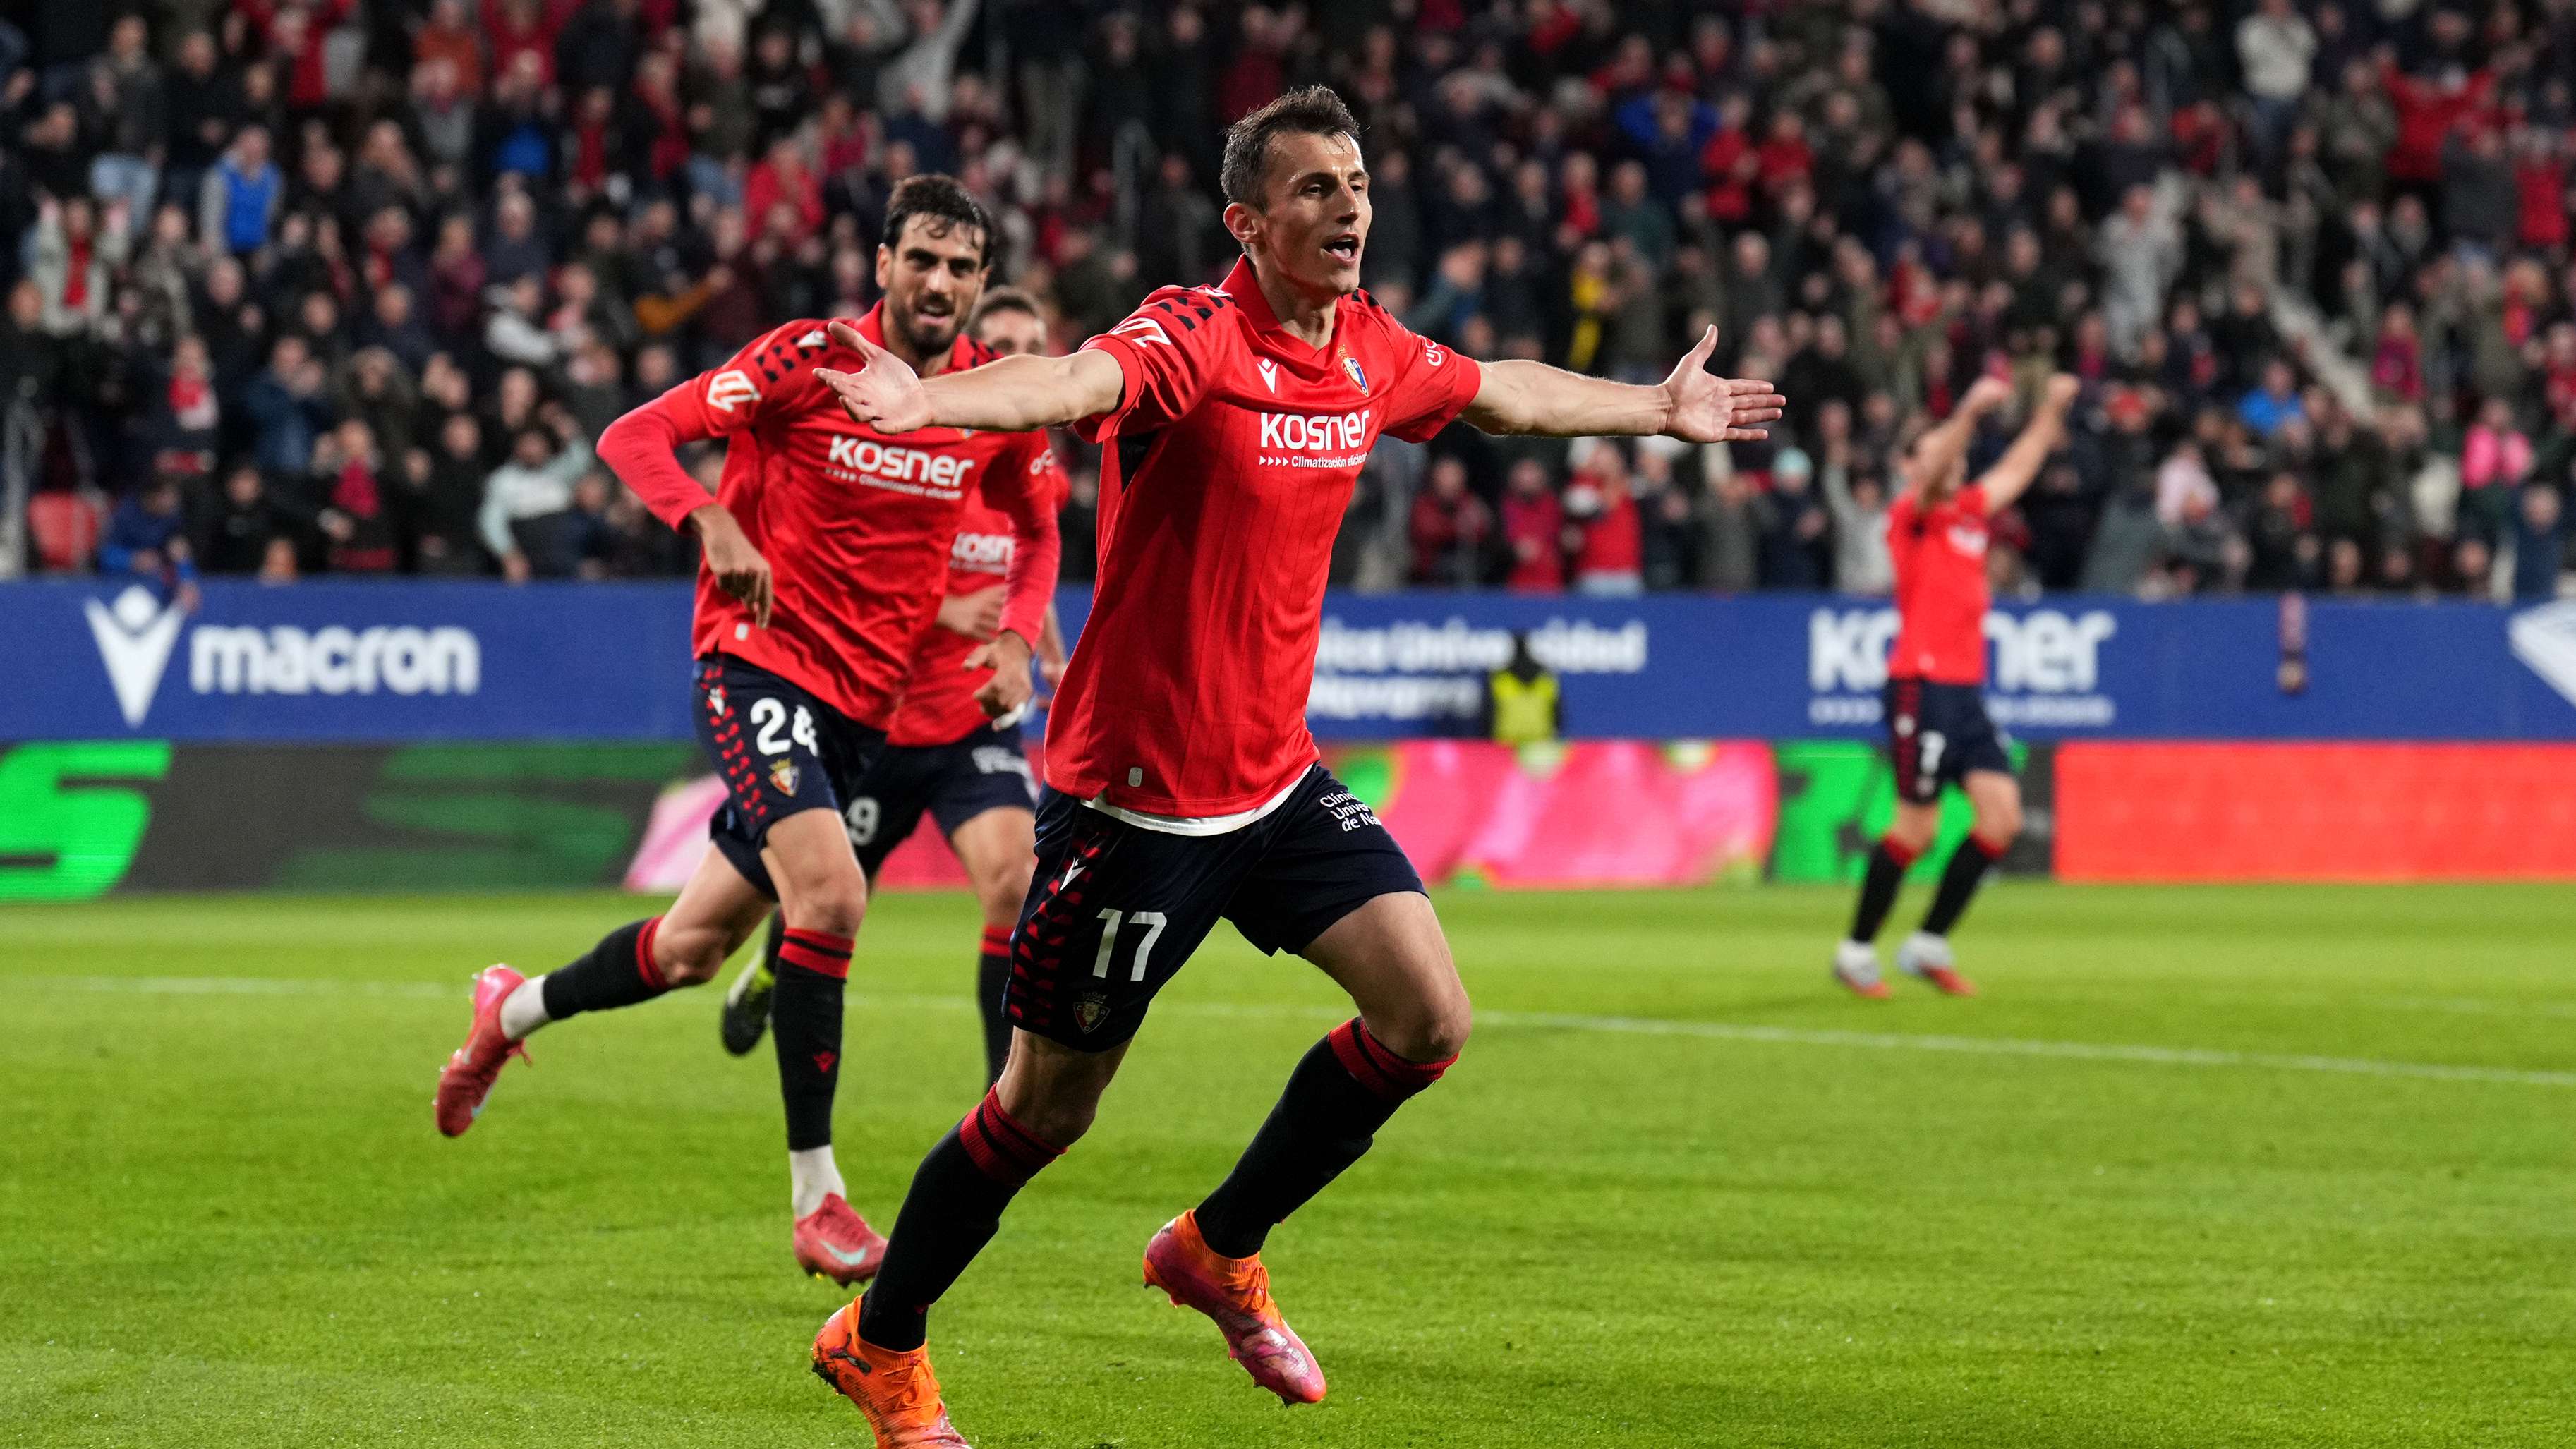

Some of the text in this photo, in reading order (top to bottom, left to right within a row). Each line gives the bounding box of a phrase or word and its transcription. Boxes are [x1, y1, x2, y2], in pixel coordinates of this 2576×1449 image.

[1291, 454, 1347, 468] Climatización
[189, 626, 482, 696] macron
[750, 696, 818, 756] 24
[1341, 812, 1383, 832] de Na
[1092, 907, 1168, 982] 17
